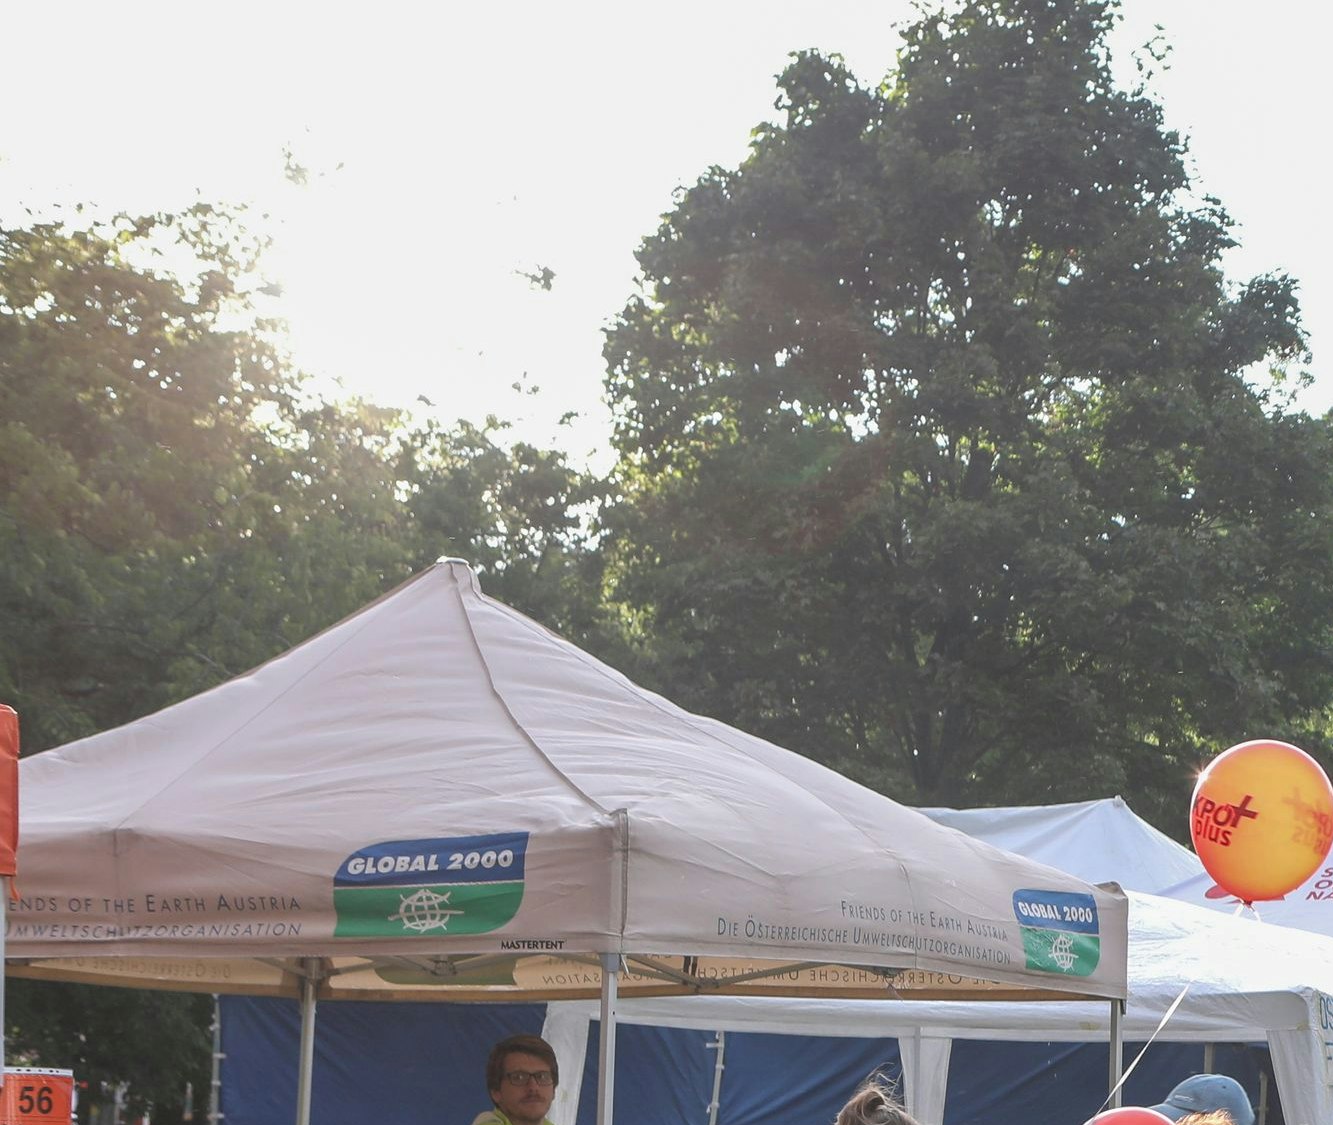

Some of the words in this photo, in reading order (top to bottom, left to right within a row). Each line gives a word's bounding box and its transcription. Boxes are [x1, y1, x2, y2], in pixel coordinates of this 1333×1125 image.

[347, 853, 439, 875] GLOBAL
[447, 849, 514, 871] 2000
[68, 897, 93, 912] OF
[103, 898, 136, 913] THE
[146, 894, 206, 913] EARTH
[216, 894, 302, 912] AUSTRIA
[1018, 901, 1062, 920] GLOBAL
[1063, 906, 1093, 923] 2000
[717, 916, 739, 937] DIE
[841, 899, 886, 921] FRIENDS
[929, 911, 961, 932] EARTH
[967, 919, 1008, 942] AUSTRIA
[500, 939, 565, 951] MASTERTENT
[18, 1086, 53, 1115] 56
